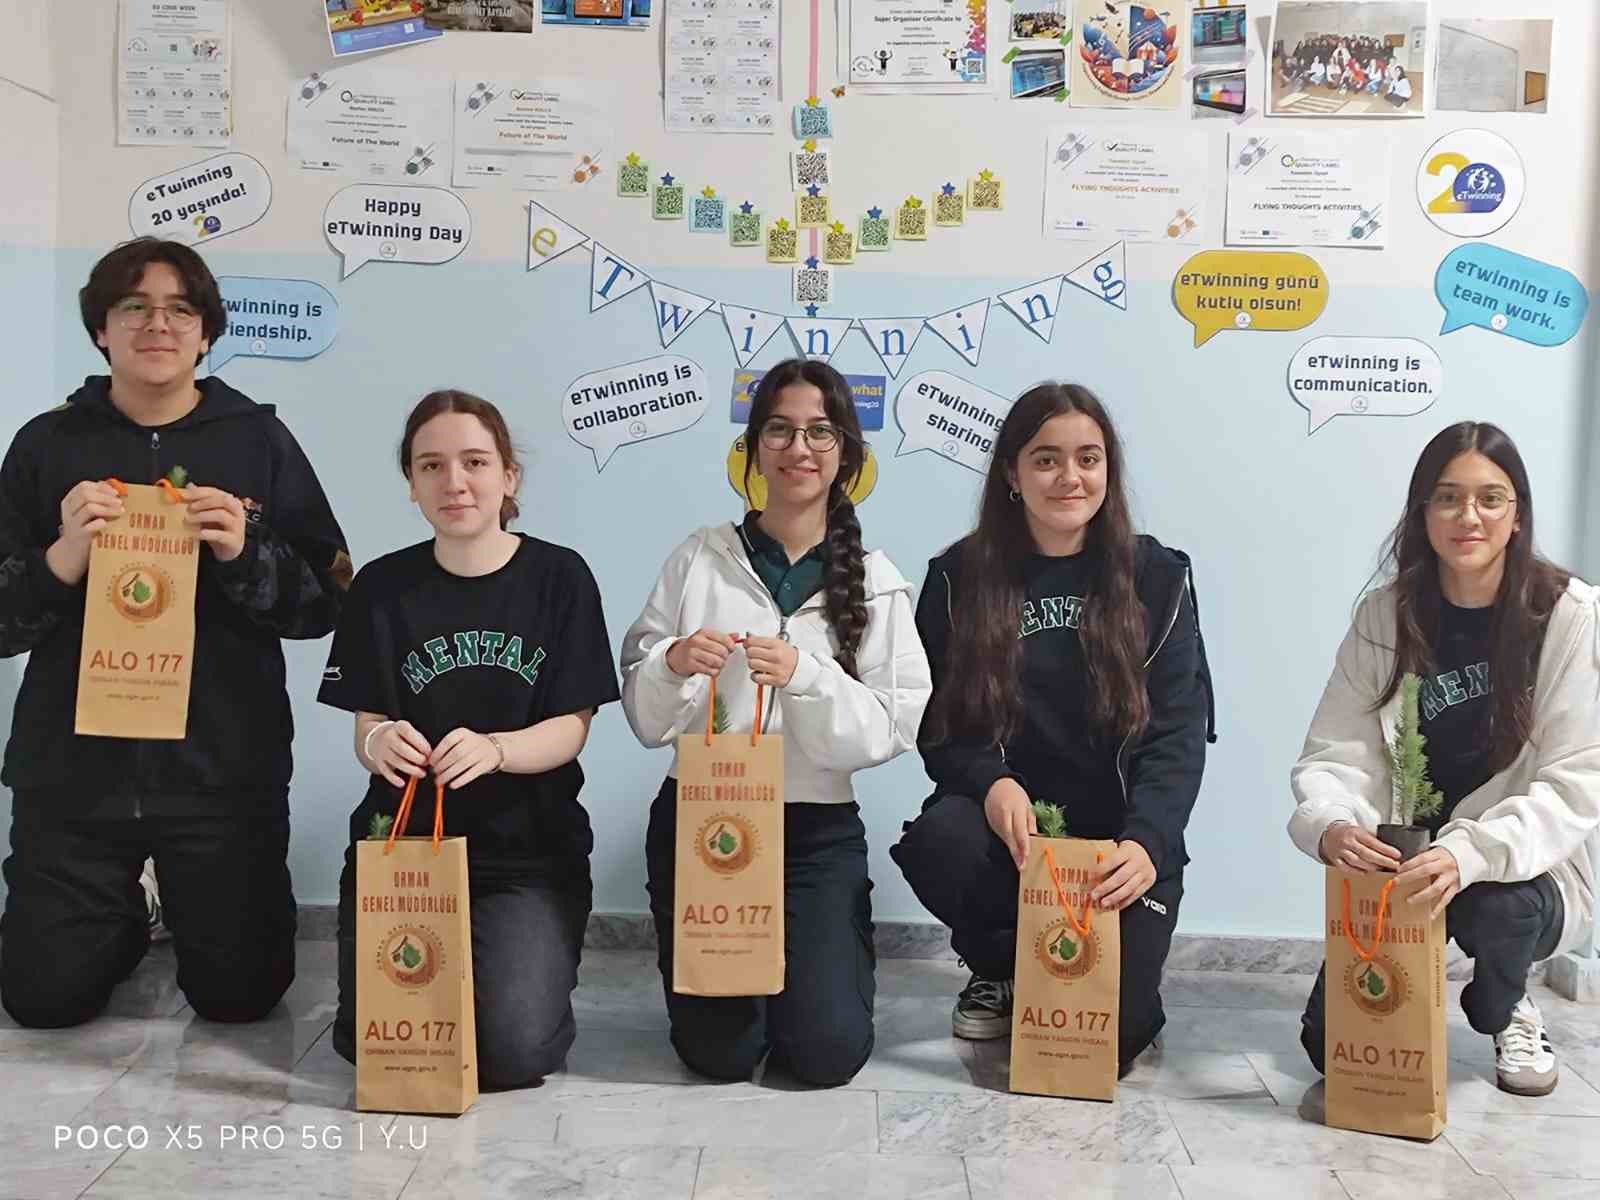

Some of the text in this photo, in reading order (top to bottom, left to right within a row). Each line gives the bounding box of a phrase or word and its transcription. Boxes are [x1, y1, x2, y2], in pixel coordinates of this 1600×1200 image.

[146, 165, 233, 202] eTwinning
[151, 182, 247, 226] 20 yaşında!
[1456, 190, 1502, 202] eTwinning
[365, 198, 421, 217] Happy
[327, 221, 462, 243] eTwinning Day
[1180, 273, 1319, 290] eTwinning günü
[1455, 260, 1571, 308] eTwinning is
[306, 301, 322, 317] is
[1196, 295, 1301, 311] kutlu olsun!
[1453, 284, 1556, 330] team work.
[1308, 355, 1421, 372] eTwinning is
[570, 364, 692, 405] eTwinning is
[1294, 378, 1433, 394] communication.
[573, 390, 703, 431] collaboration.
[916, 382, 1005, 432] eTwinning
[128, 511, 165, 530] ORMAN
[89, 649, 184, 673] ALO 177
[401, 630, 546, 695] MENTAL
[393, 871, 431, 888] ORMAN
[361, 895, 395, 913] GENEL
[1023, 888, 1054, 906] GENEL
[682, 903, 772, 925] ALO 177
[1020, 1006, 1111, 1032] ALO 177
[365, 1019, 457, 1043] ALO 177
[1333, 1041, 1426, 1071] ALO 177
